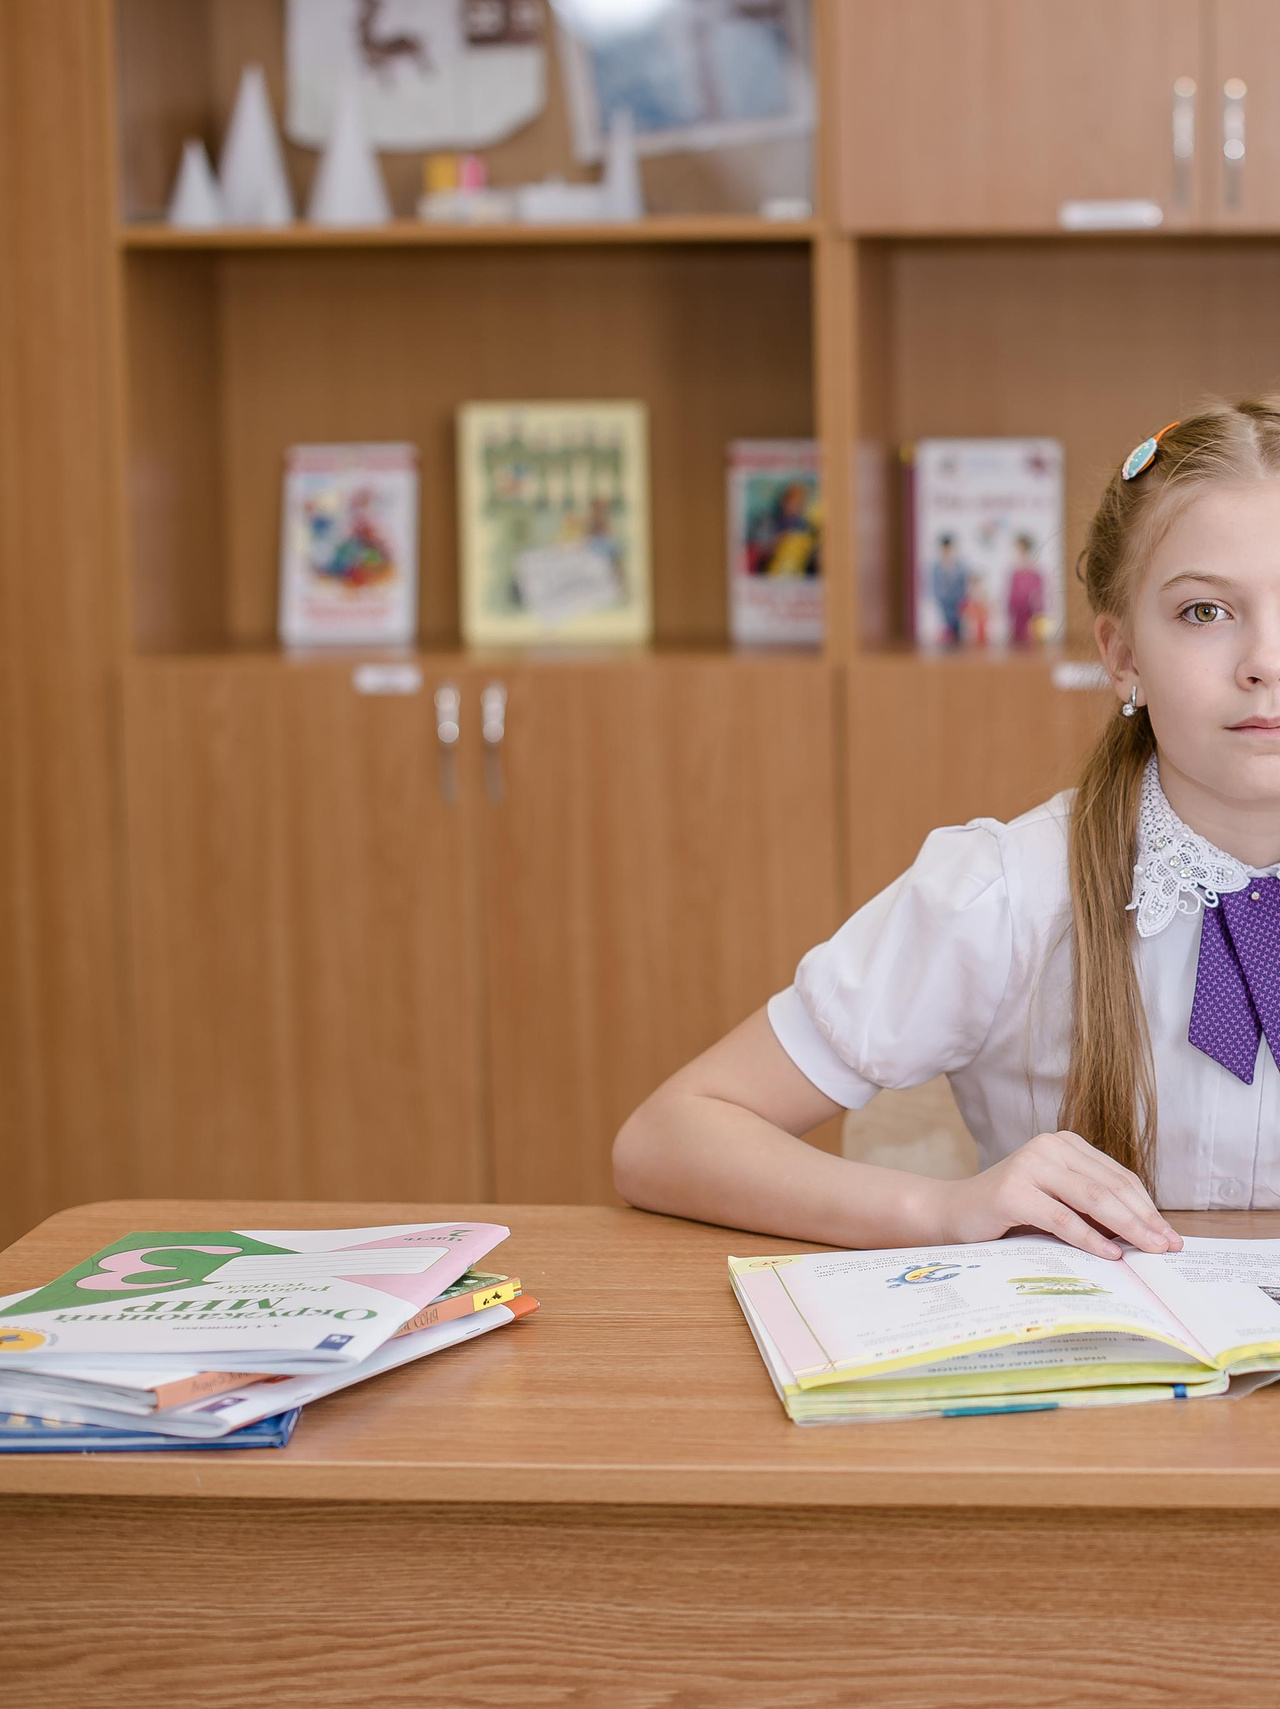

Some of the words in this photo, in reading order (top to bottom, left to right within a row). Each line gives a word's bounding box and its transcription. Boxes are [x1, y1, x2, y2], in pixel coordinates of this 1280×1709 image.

[75, 1244, 243, 1291] 3
[122, 1297, 291, 1312] МИР
[53, 1307, 379, 1323] Окружающий
